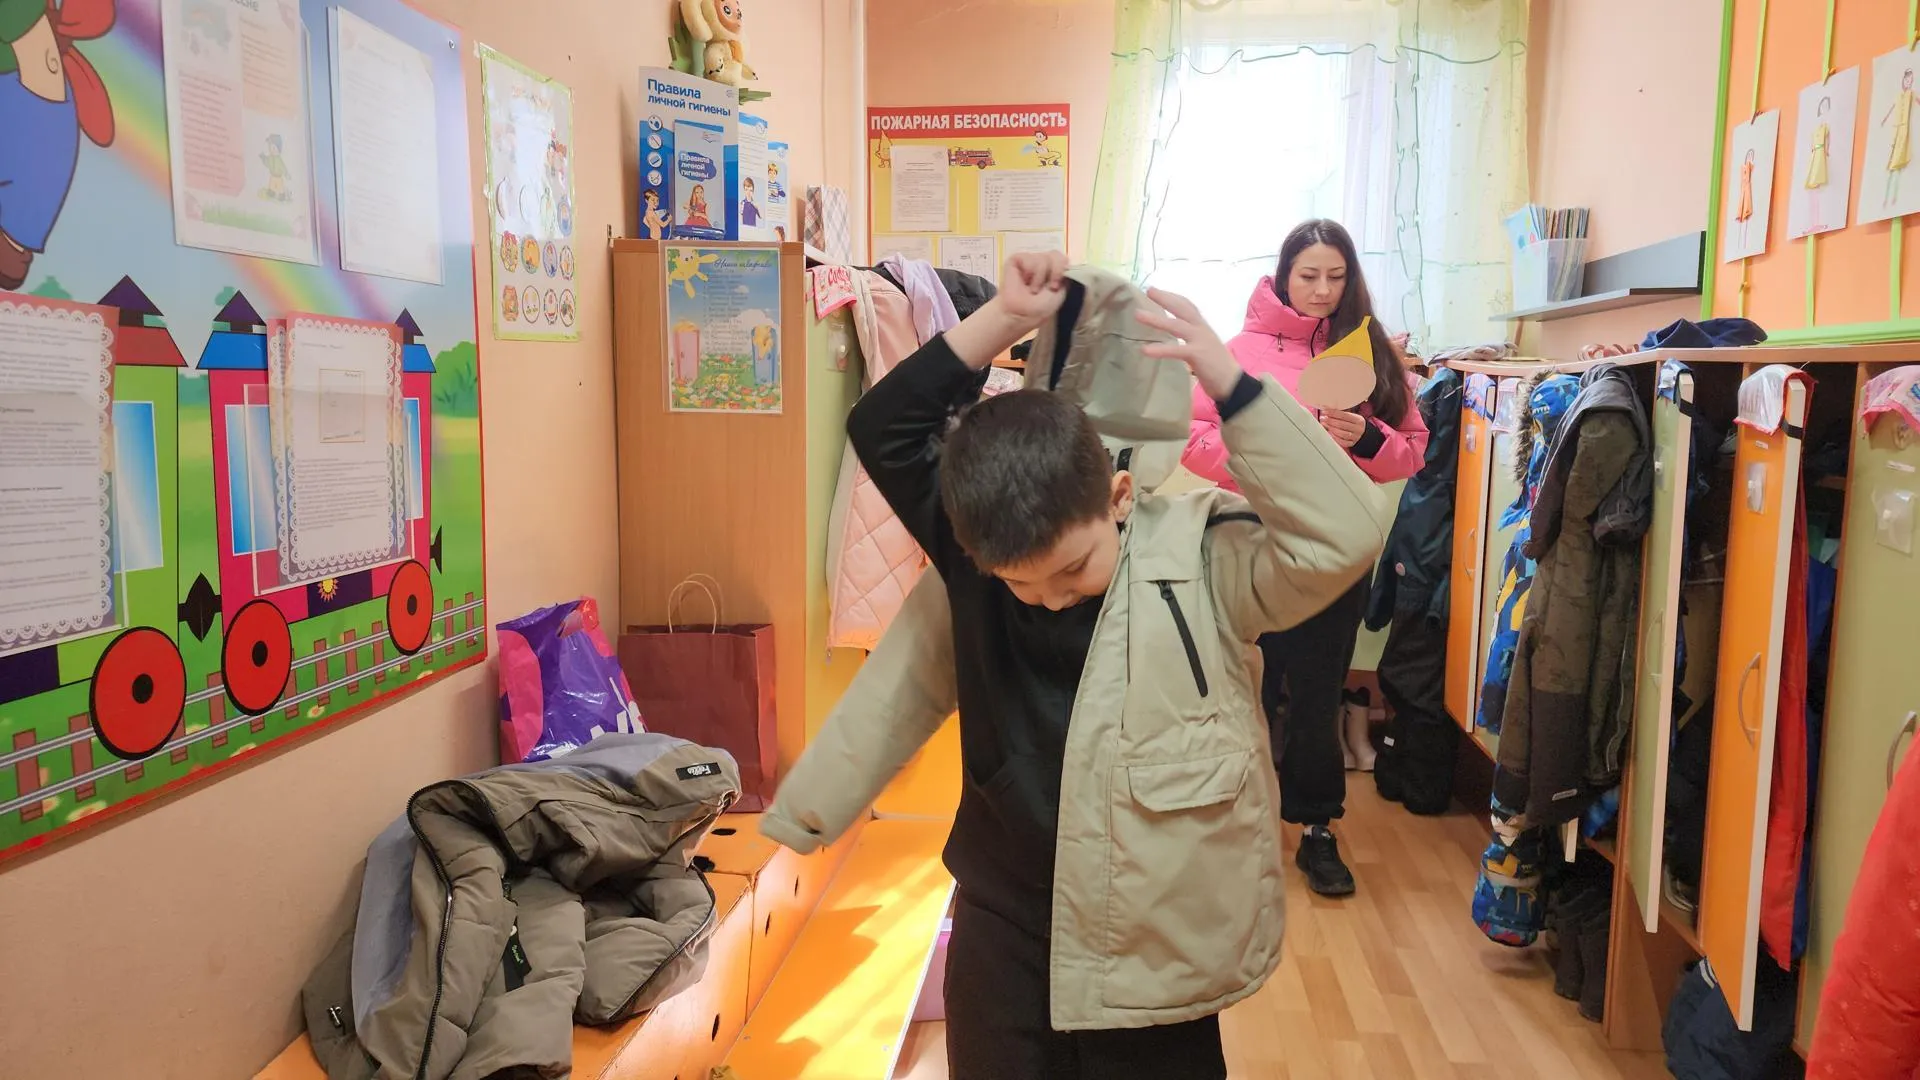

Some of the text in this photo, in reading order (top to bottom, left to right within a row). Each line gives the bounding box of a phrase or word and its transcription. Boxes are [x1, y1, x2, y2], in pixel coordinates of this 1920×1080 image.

[648, 79, 701, 99] Правила
[648, 95, 731, 117] личной гигиены
[871, 112, 1067, 130] ПОЖАРНАЯ БЕЗОПАСНОСТЬ
[680, 153, 710, 164] Правила
